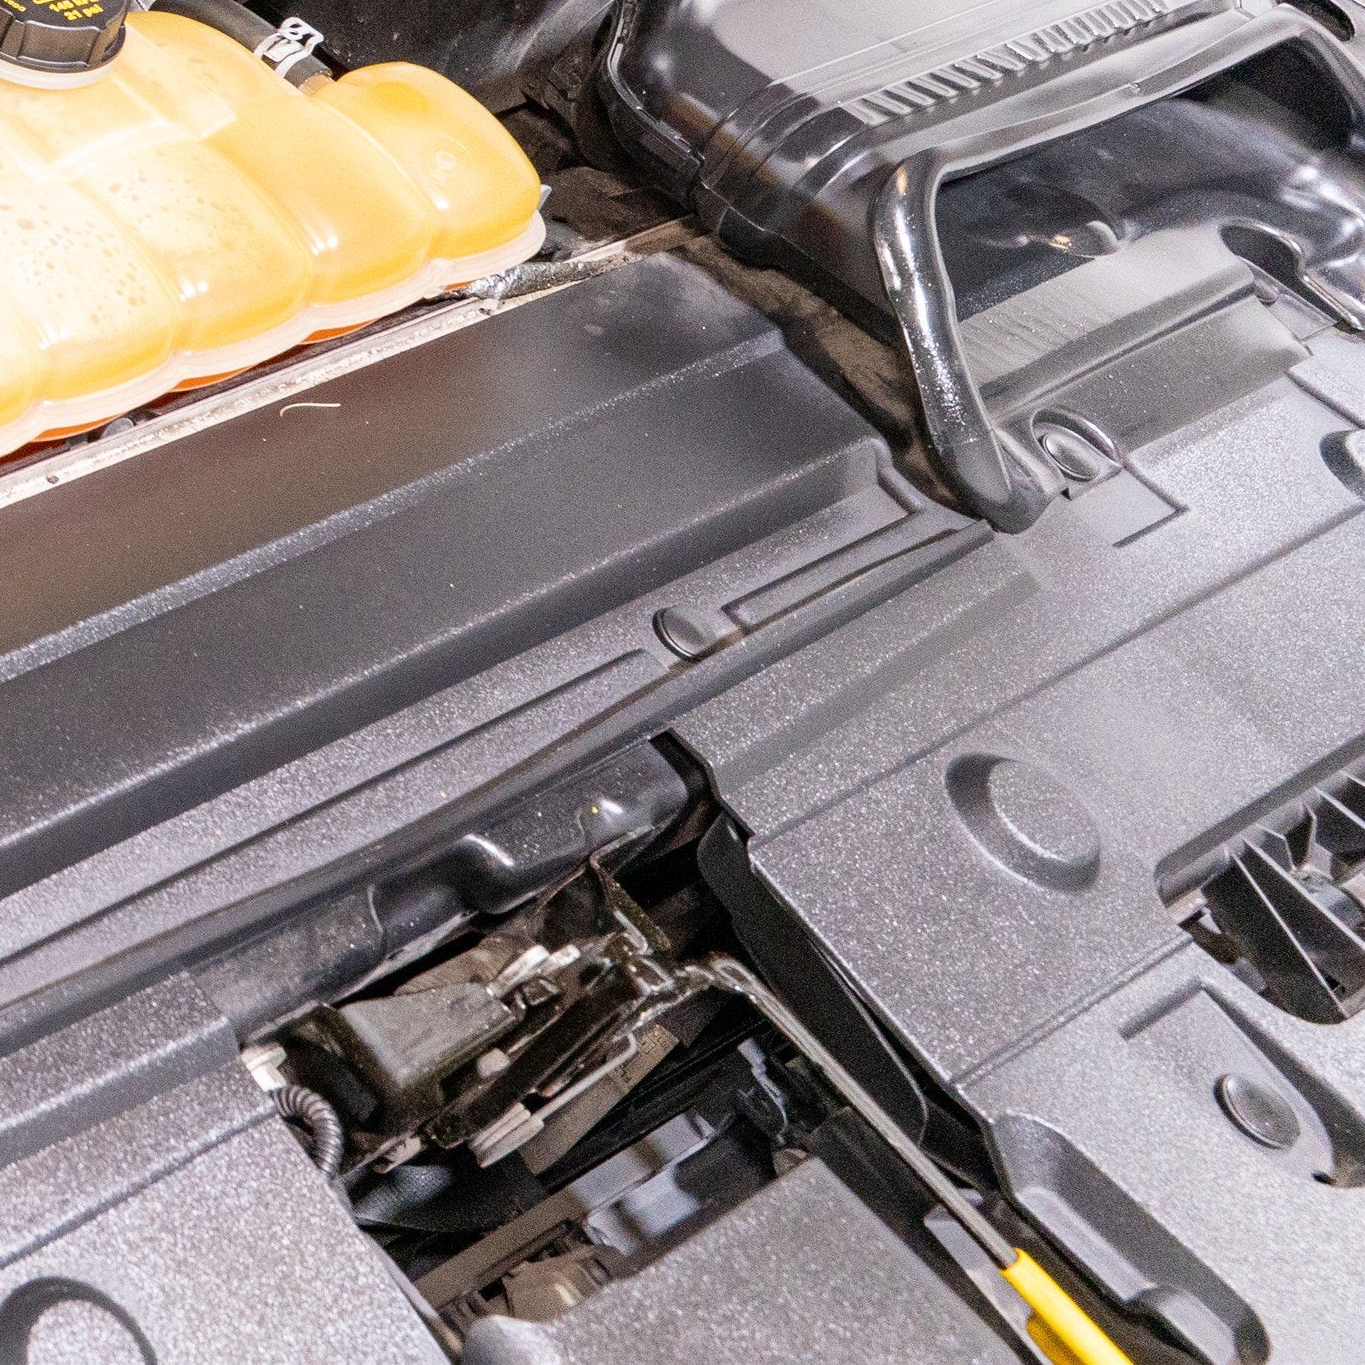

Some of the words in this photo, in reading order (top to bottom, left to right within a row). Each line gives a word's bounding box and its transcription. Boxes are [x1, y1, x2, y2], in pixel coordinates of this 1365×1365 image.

[48, 0, 74, 14] 145
[63, 9, 82, 21] 21
[82, 4, 105, 19] psi
